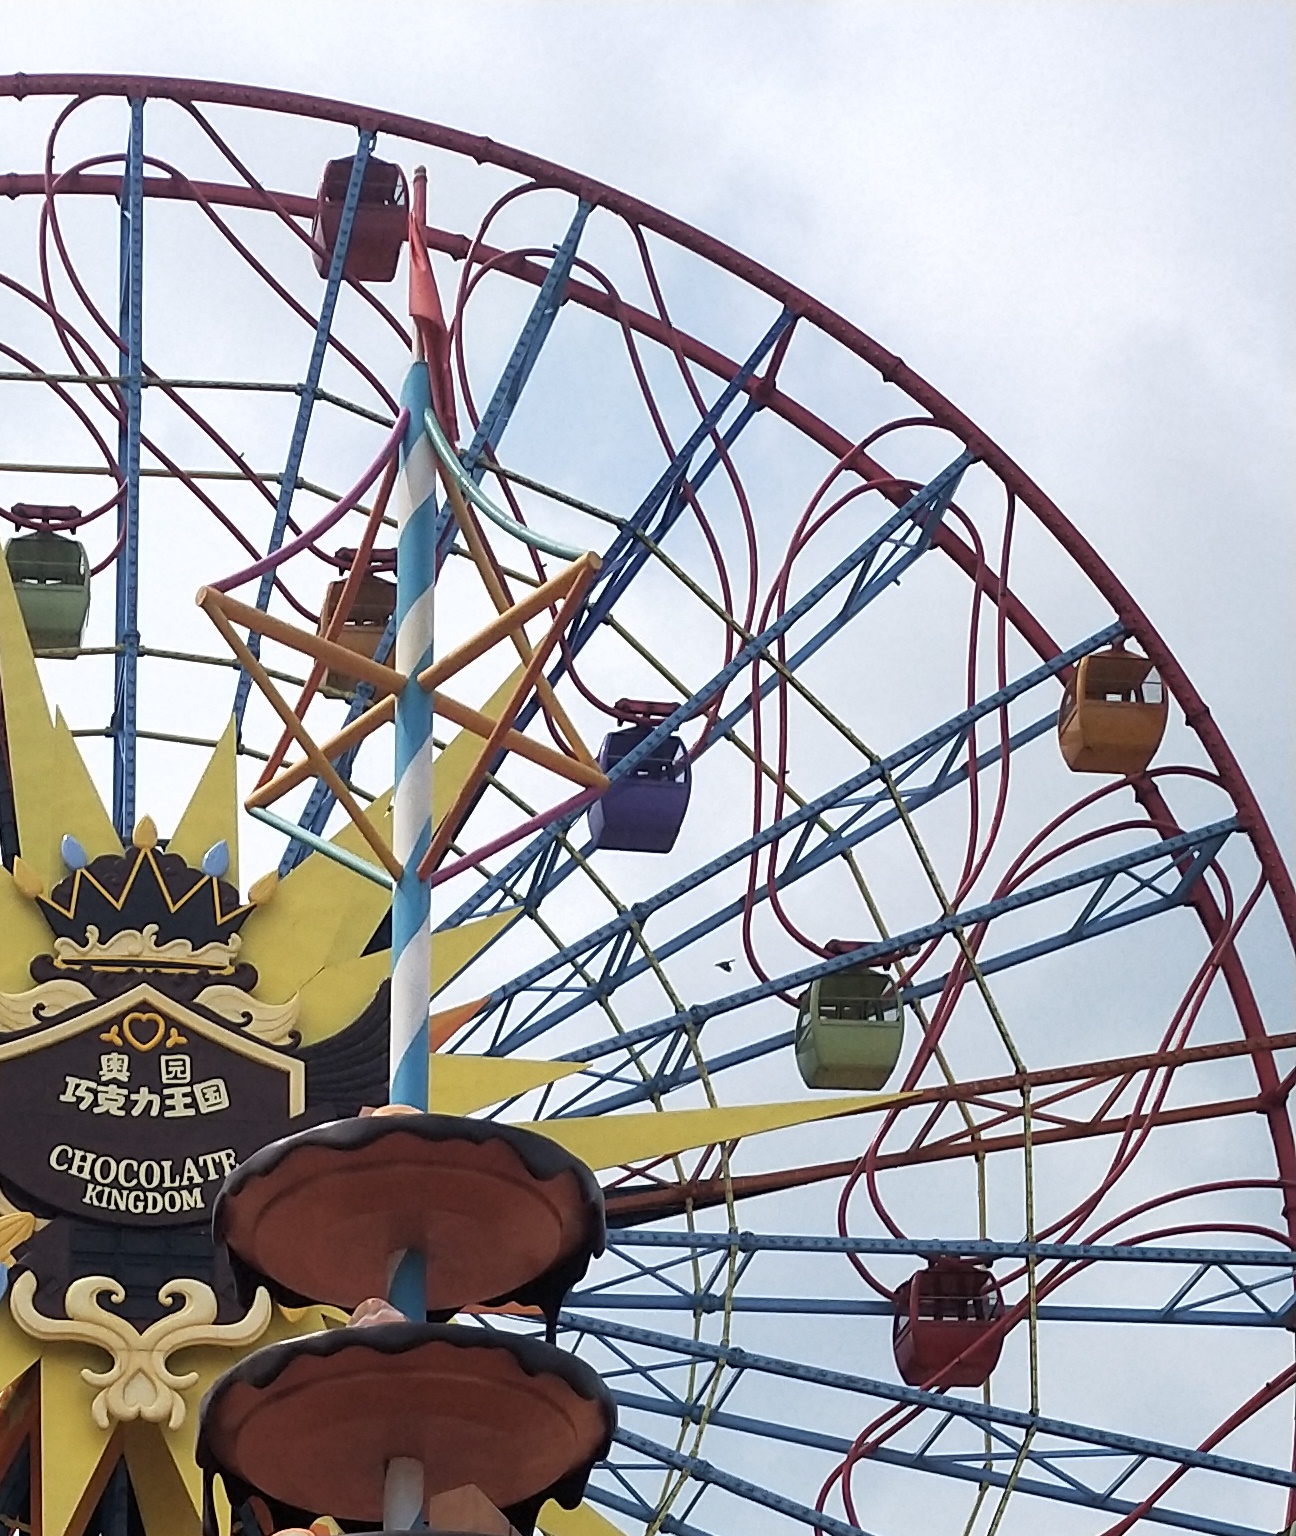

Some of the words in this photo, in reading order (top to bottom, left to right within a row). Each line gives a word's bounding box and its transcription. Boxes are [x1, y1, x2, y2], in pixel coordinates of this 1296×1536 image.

[59, 1075, 230, 1118] 巧克力王国
[49, 1144, 239, 1189] CHOCOLATE
[82, 1182, 206, 1214] KINGDOM
